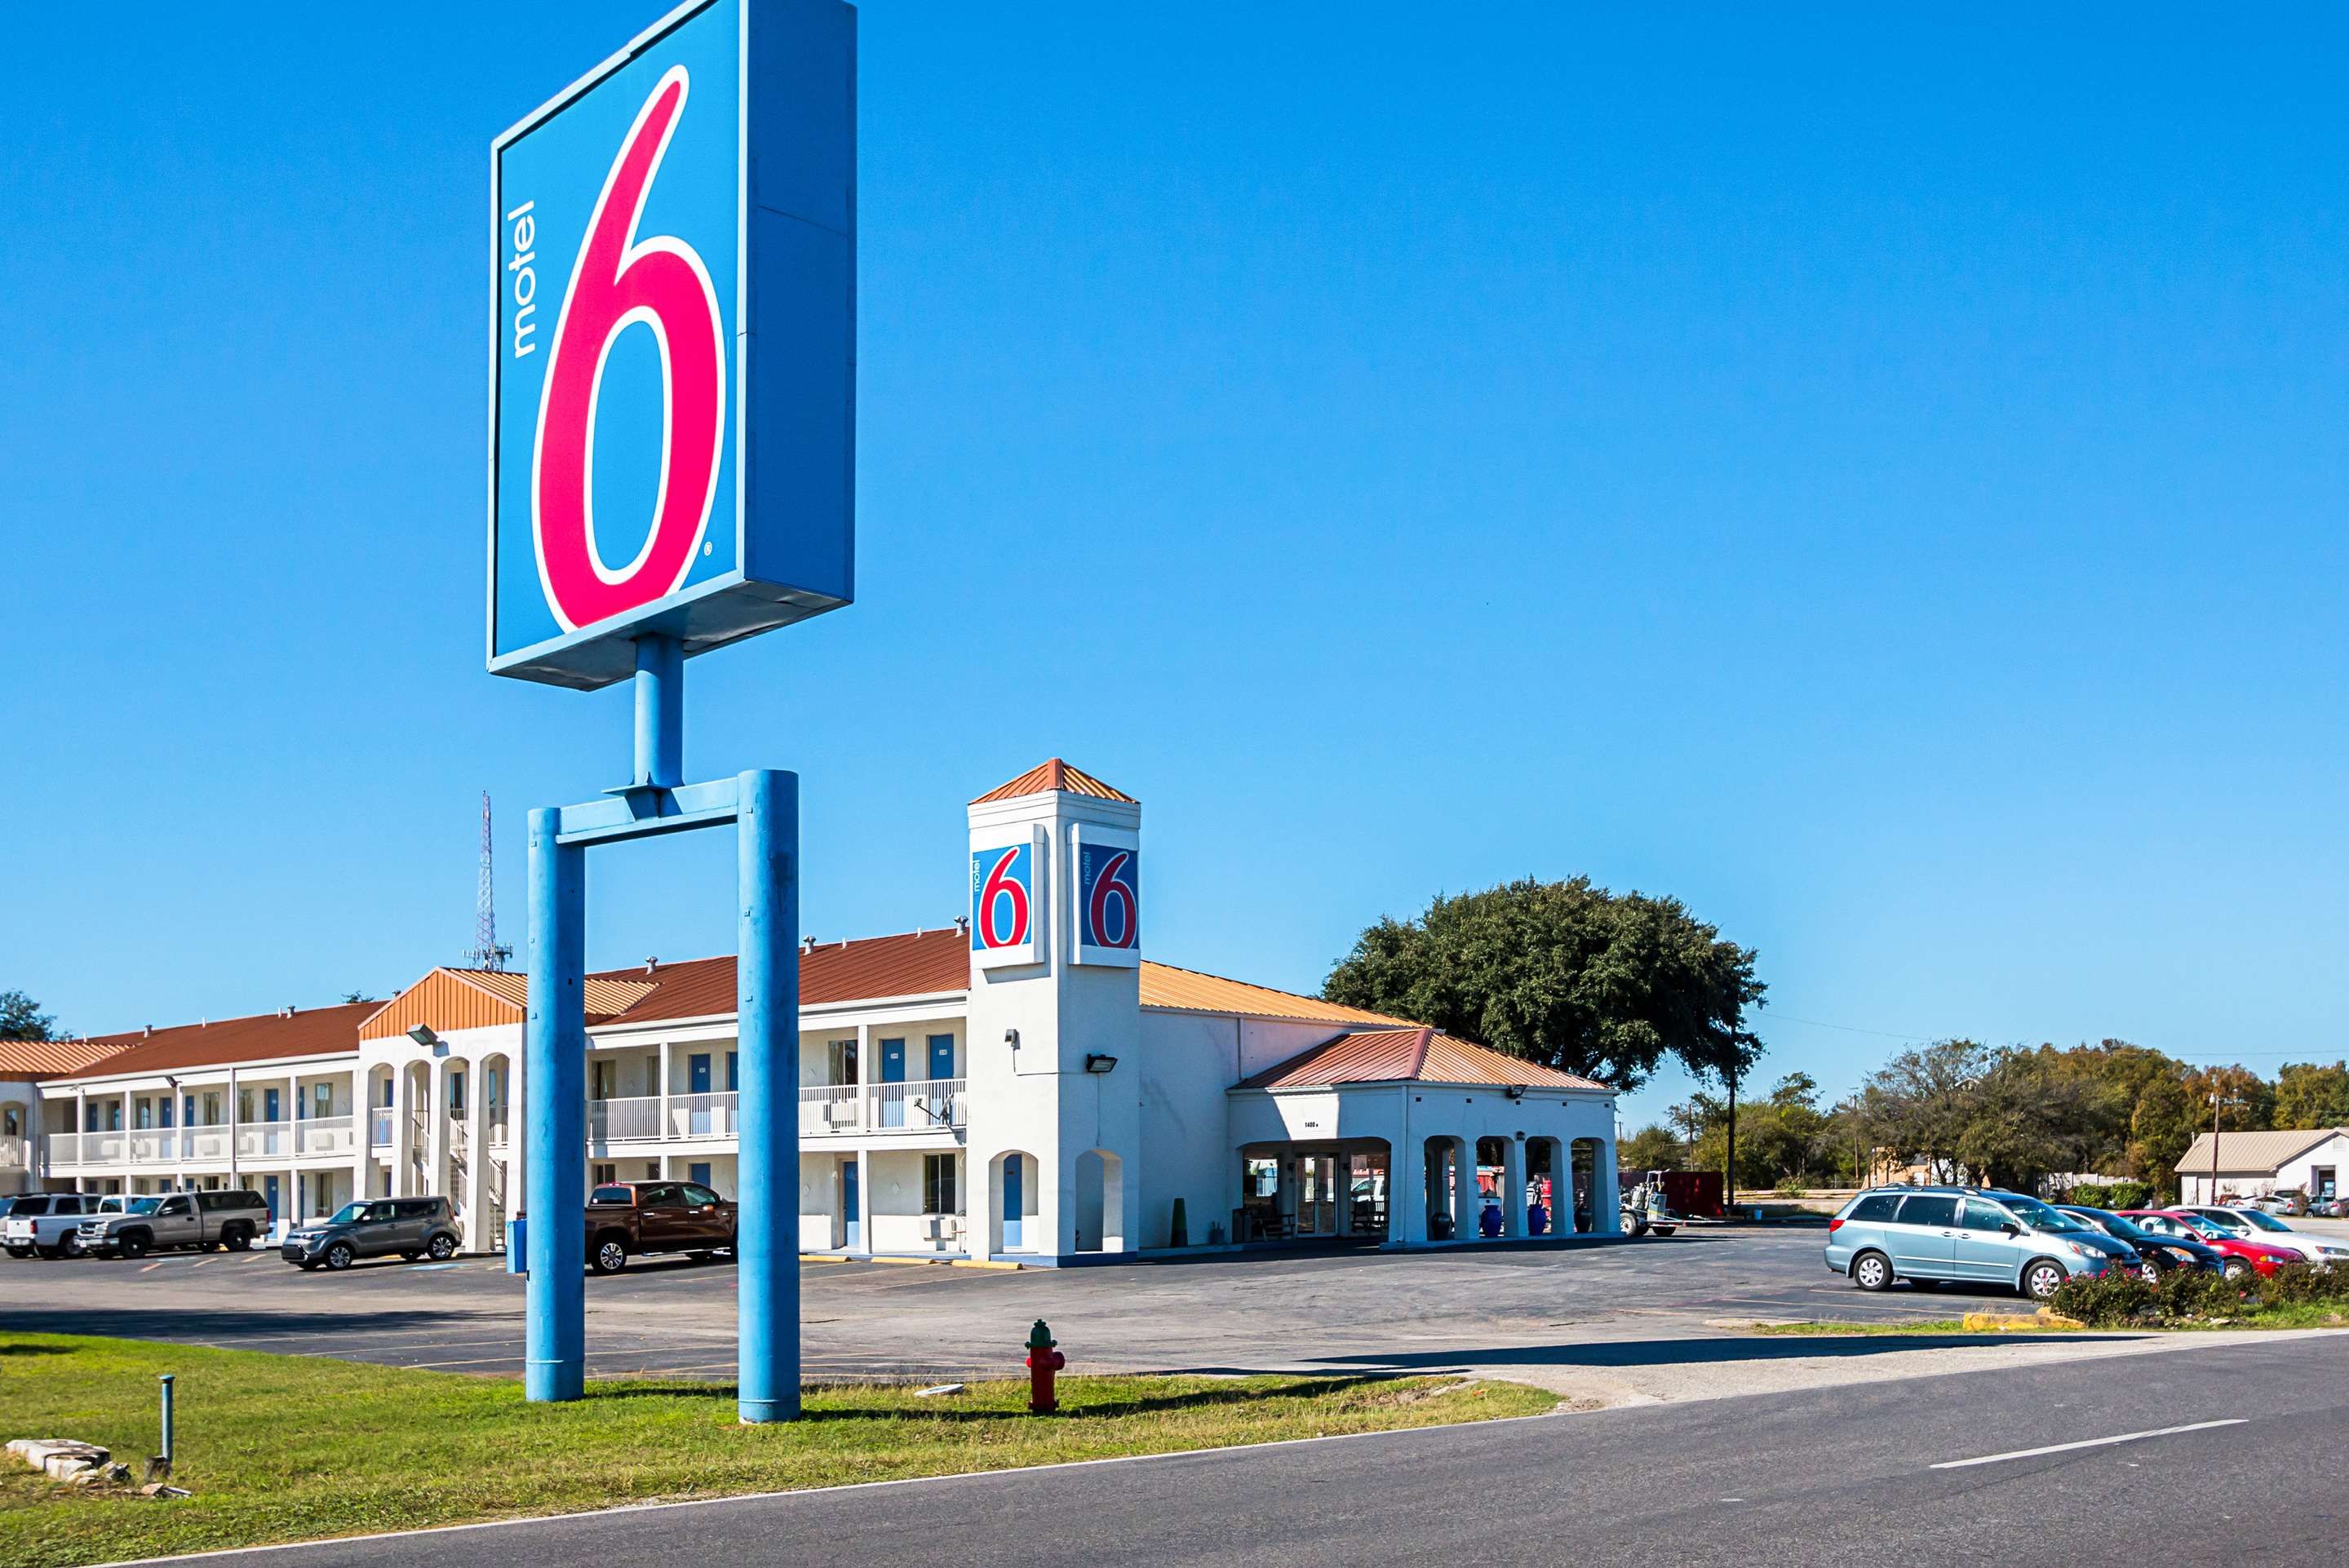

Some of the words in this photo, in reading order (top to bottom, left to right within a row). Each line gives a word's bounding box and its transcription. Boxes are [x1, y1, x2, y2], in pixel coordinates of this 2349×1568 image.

[507, 200, 536, 359] motel
[532, 64, 726, 633] 6
[973, 859, 981, 893] motel
[978, 846, 1030, 949] 6
[1083, 852, 1091, 885] motel
[1089, 851, 1138, 949] 6
